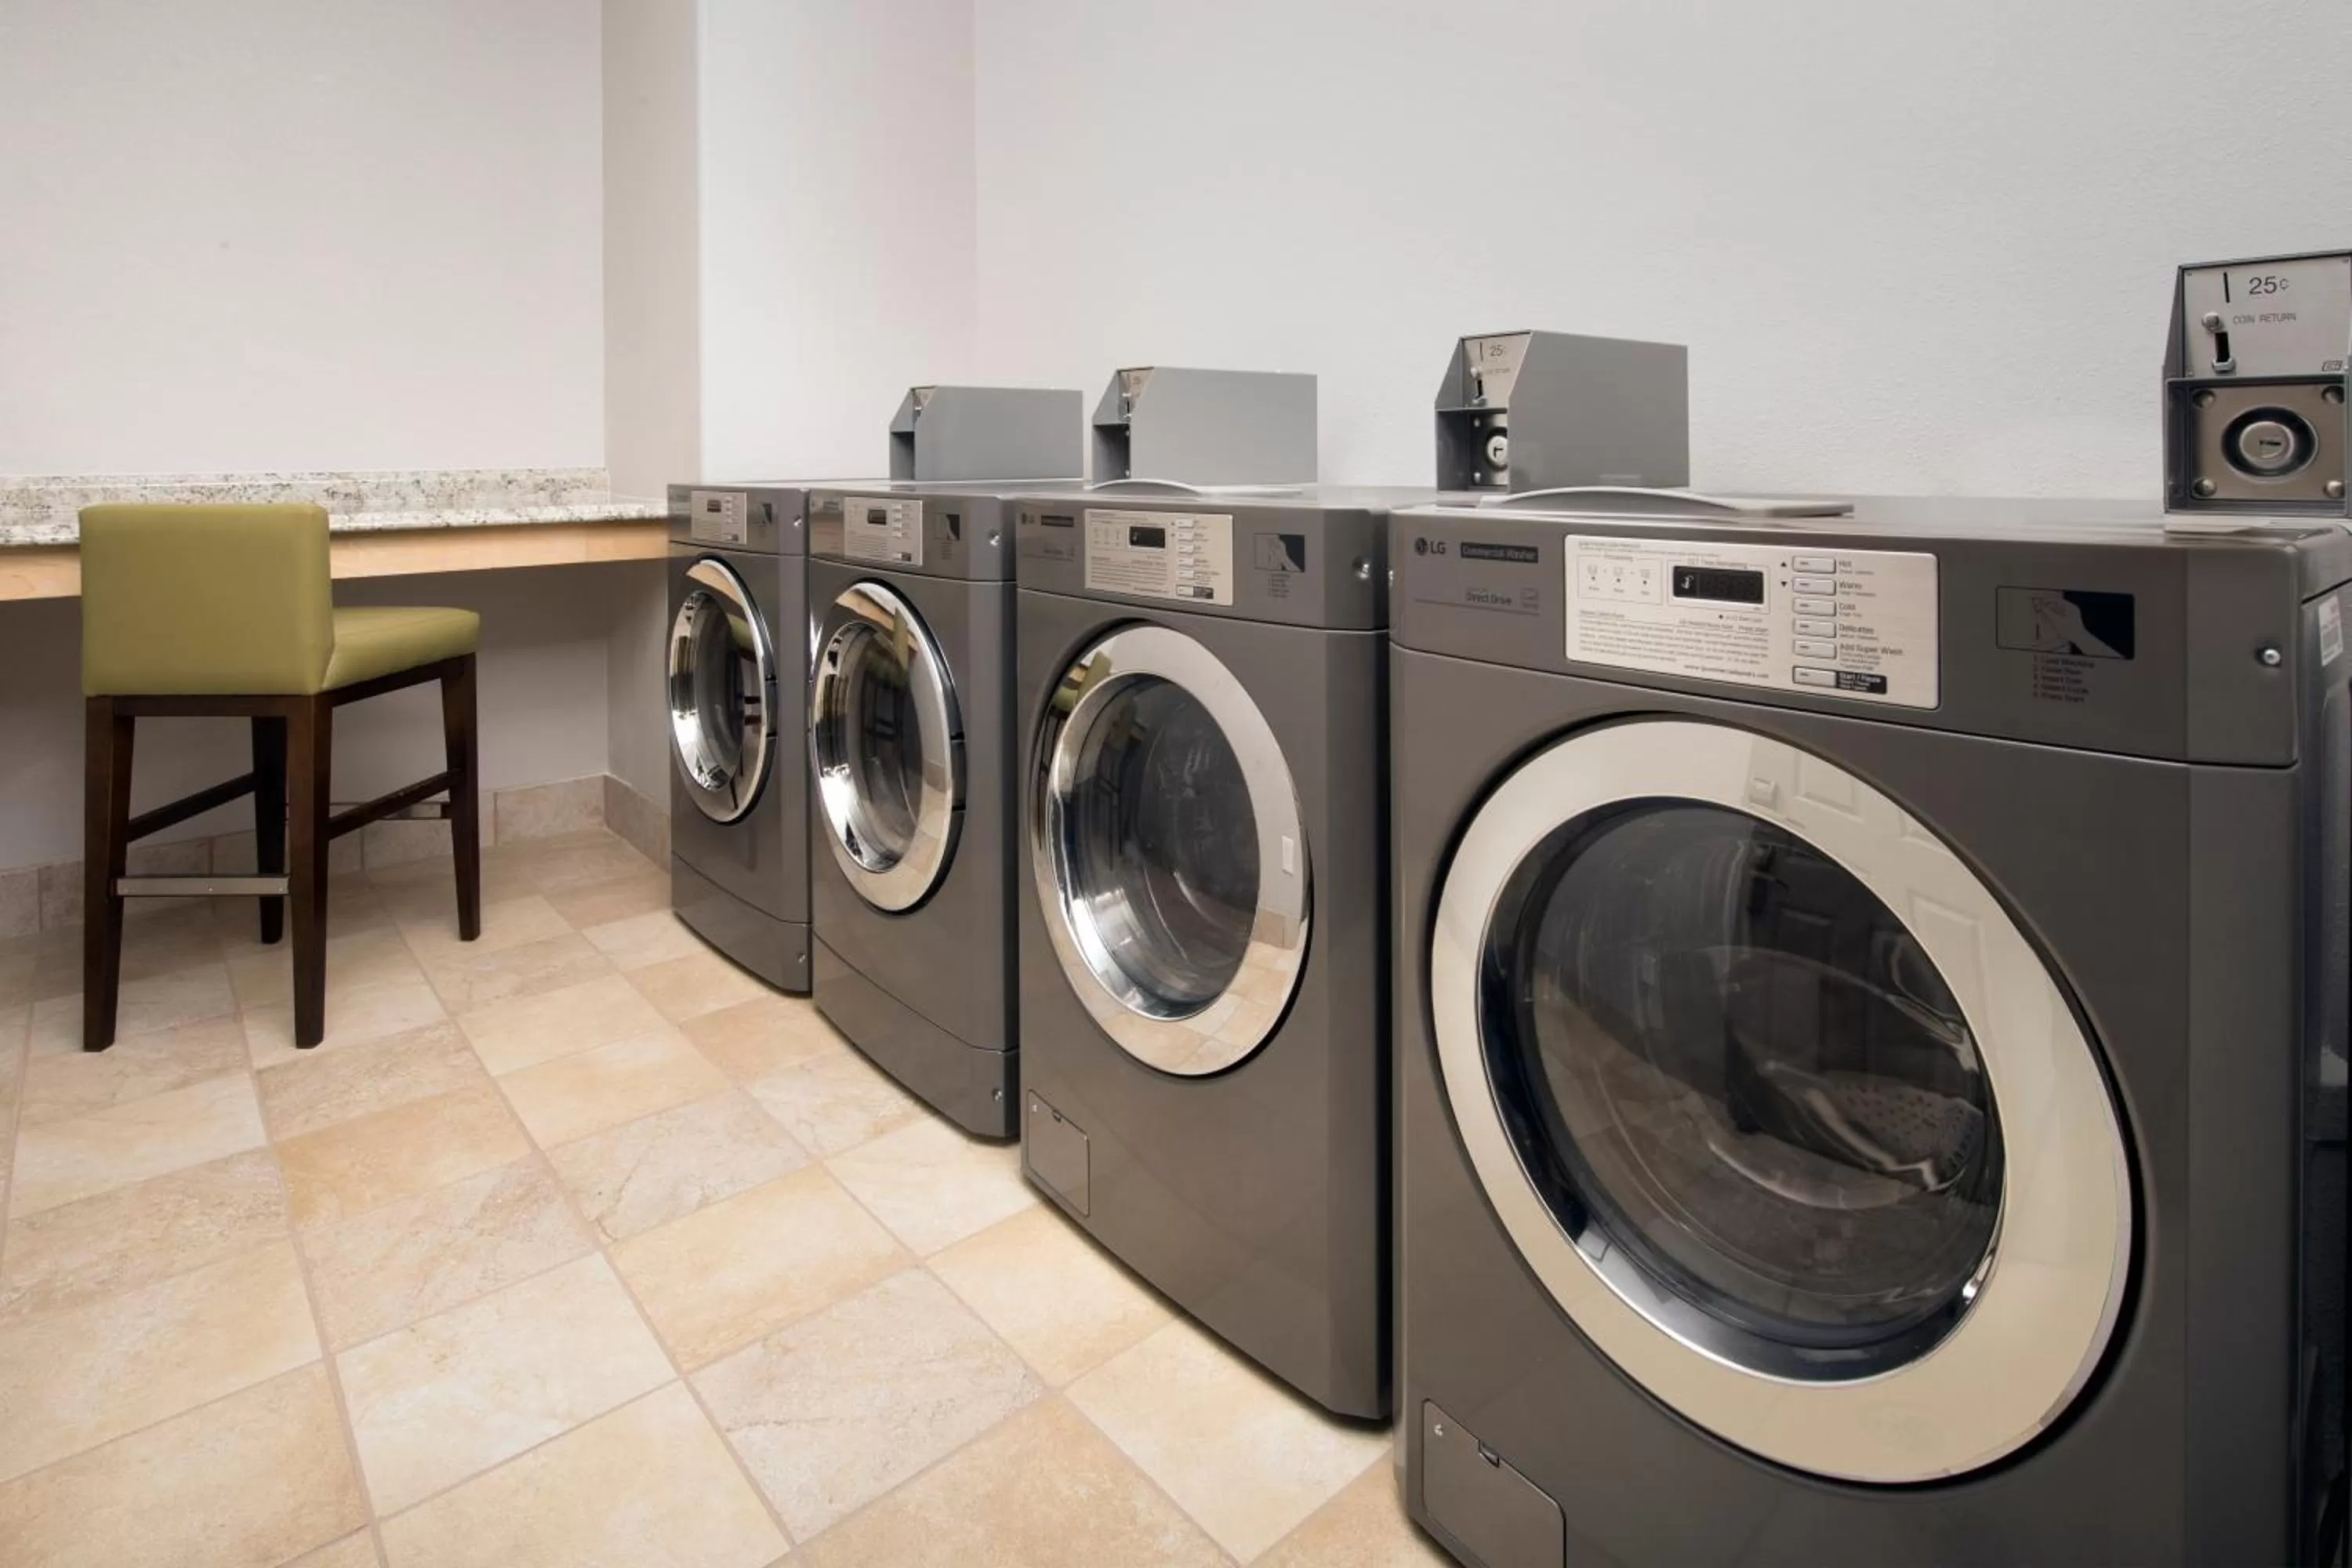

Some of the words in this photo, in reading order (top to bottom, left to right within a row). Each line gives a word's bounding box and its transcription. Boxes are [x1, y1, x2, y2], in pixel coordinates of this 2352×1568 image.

[2249, 275, 2290, 296] 25¢
[2232, 314, 2256, 325] COIN
[2259, 313, 2297, 323] RETURN
[1429, 540, 1446, 555] LG
